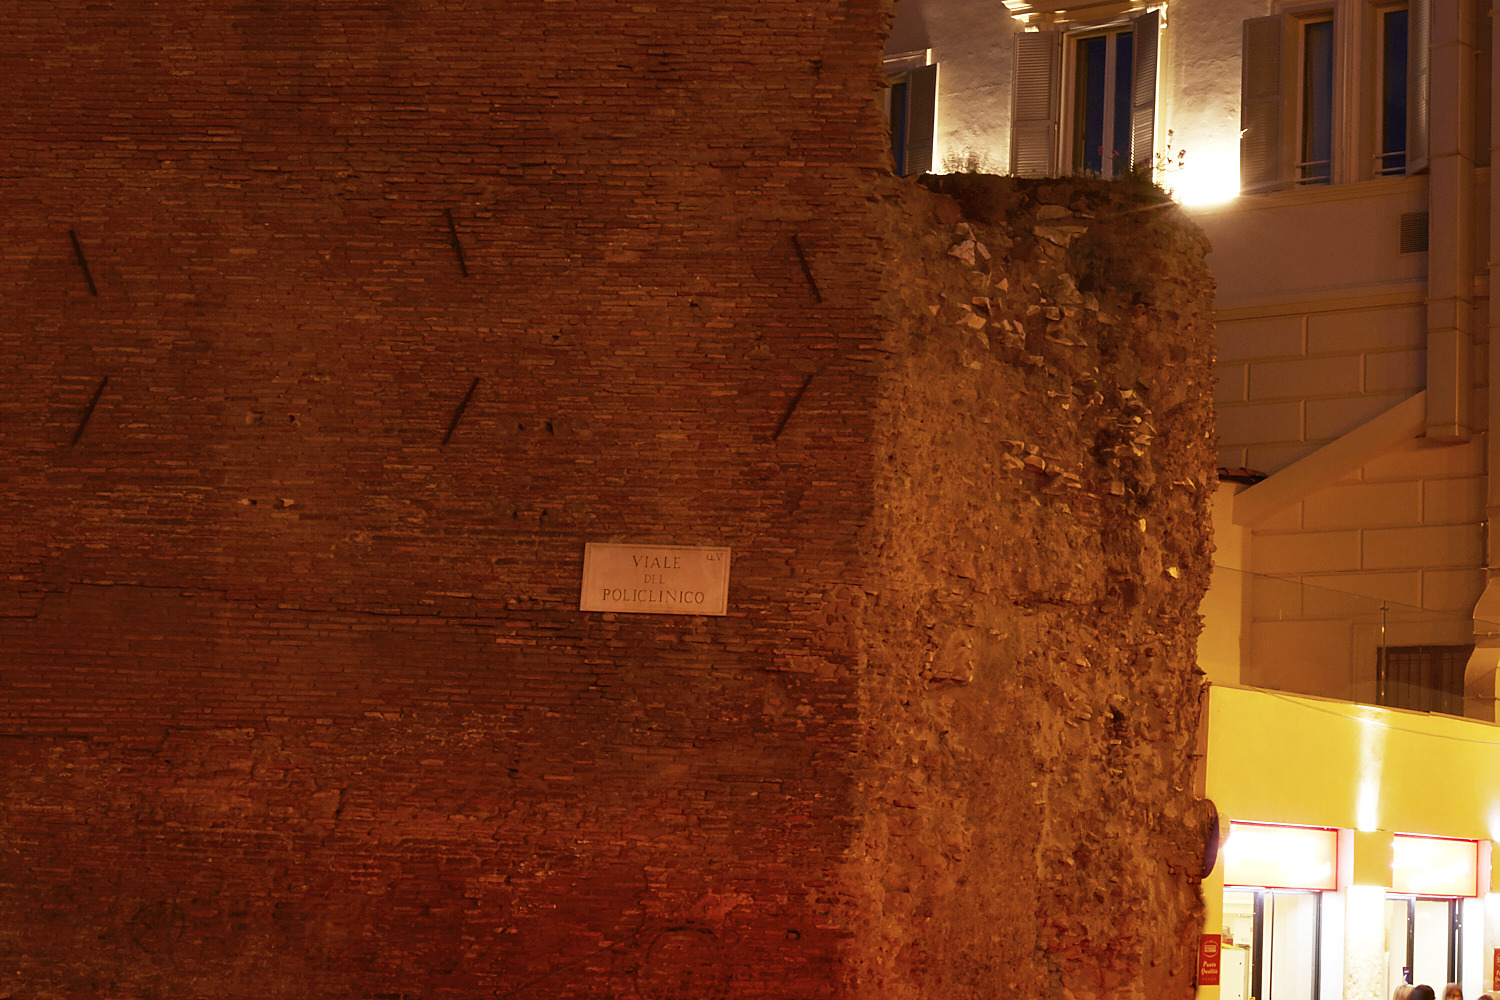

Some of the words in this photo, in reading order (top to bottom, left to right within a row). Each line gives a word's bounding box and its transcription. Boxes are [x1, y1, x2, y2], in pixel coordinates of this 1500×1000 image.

[632, 555, 681, 569] VIALE
[644, 574, 664, 584] DEL
[602, 588, 705, 604] POLICLINICO
